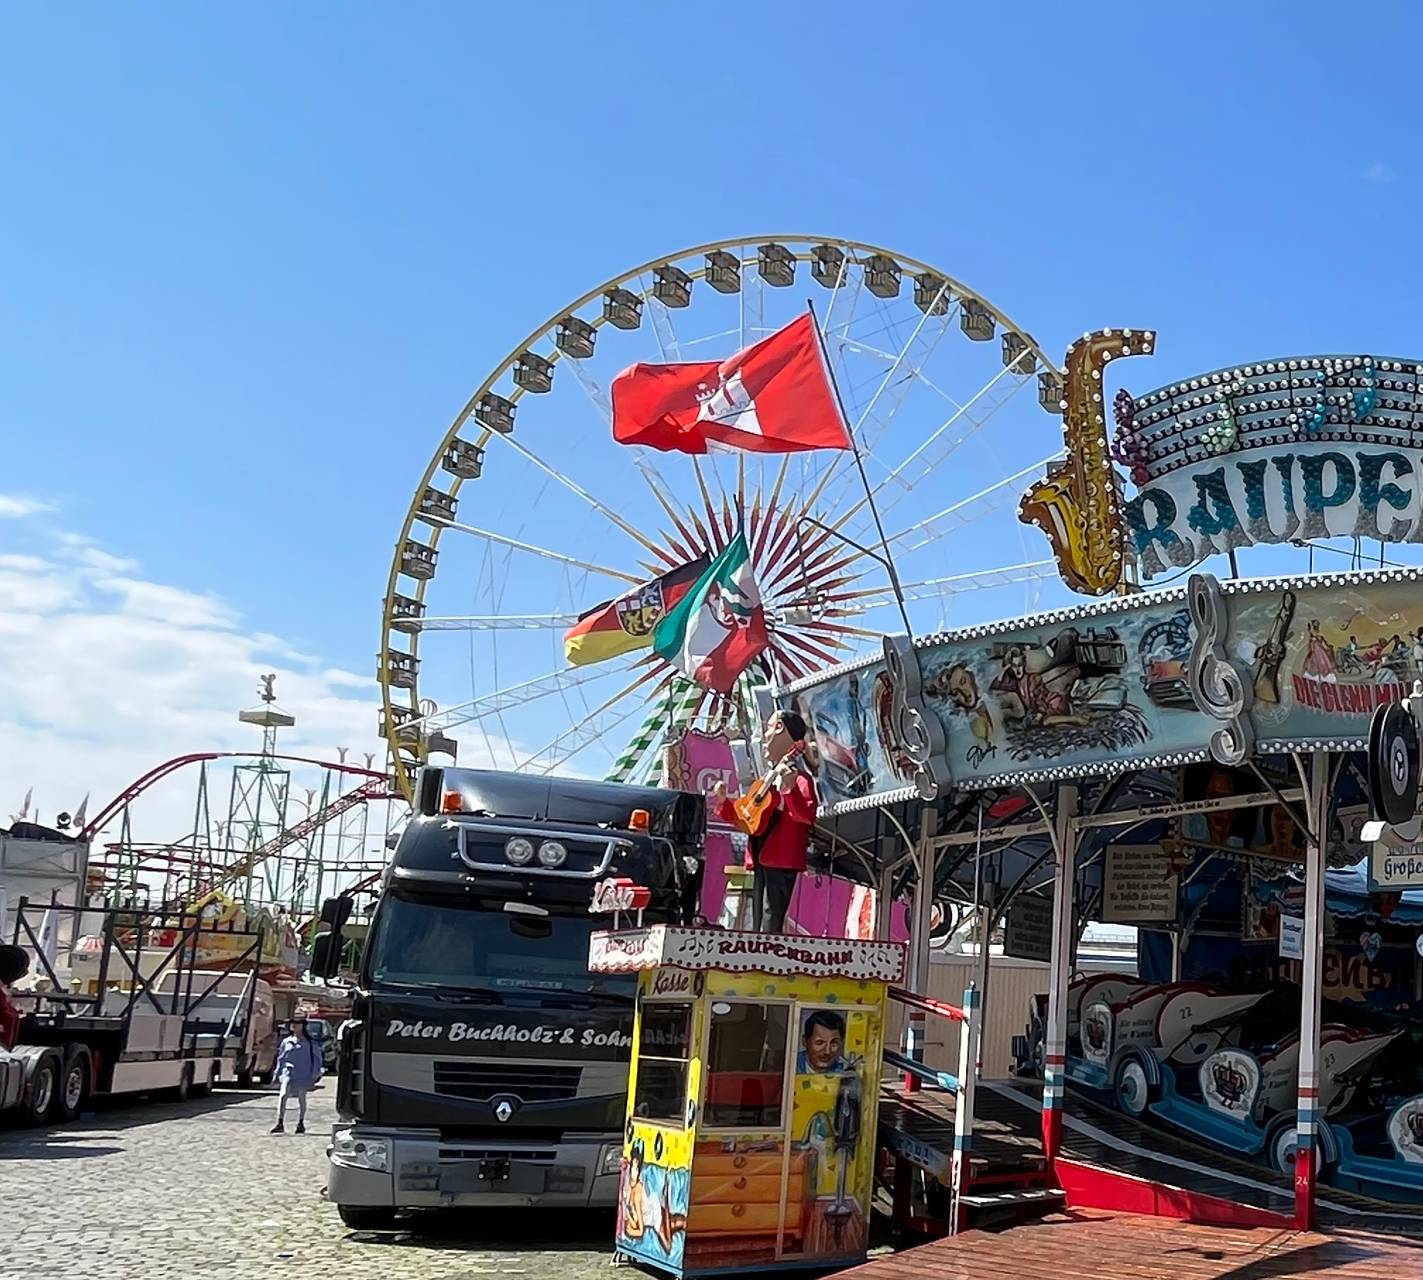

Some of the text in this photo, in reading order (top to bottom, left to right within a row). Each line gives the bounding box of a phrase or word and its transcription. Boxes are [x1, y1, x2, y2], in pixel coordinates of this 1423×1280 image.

[1292, 674, 1320, 708] DIE
[1325, 680, 1373, 713] GLENN
[718, 940, 853, 965] RAUPENBAHN
[653, 969, 689, 995] Kasse
[1179, 1007, 1193, 1019] 22
[386, 1020, 442, 1038] Peter
[448, 1022, 555, 1043] Buchholz
[558, 1028, 574, 1045] &
[580, 1028, 632, 1048] Sohn
[1324, 1054, 1337, 1068] 23
